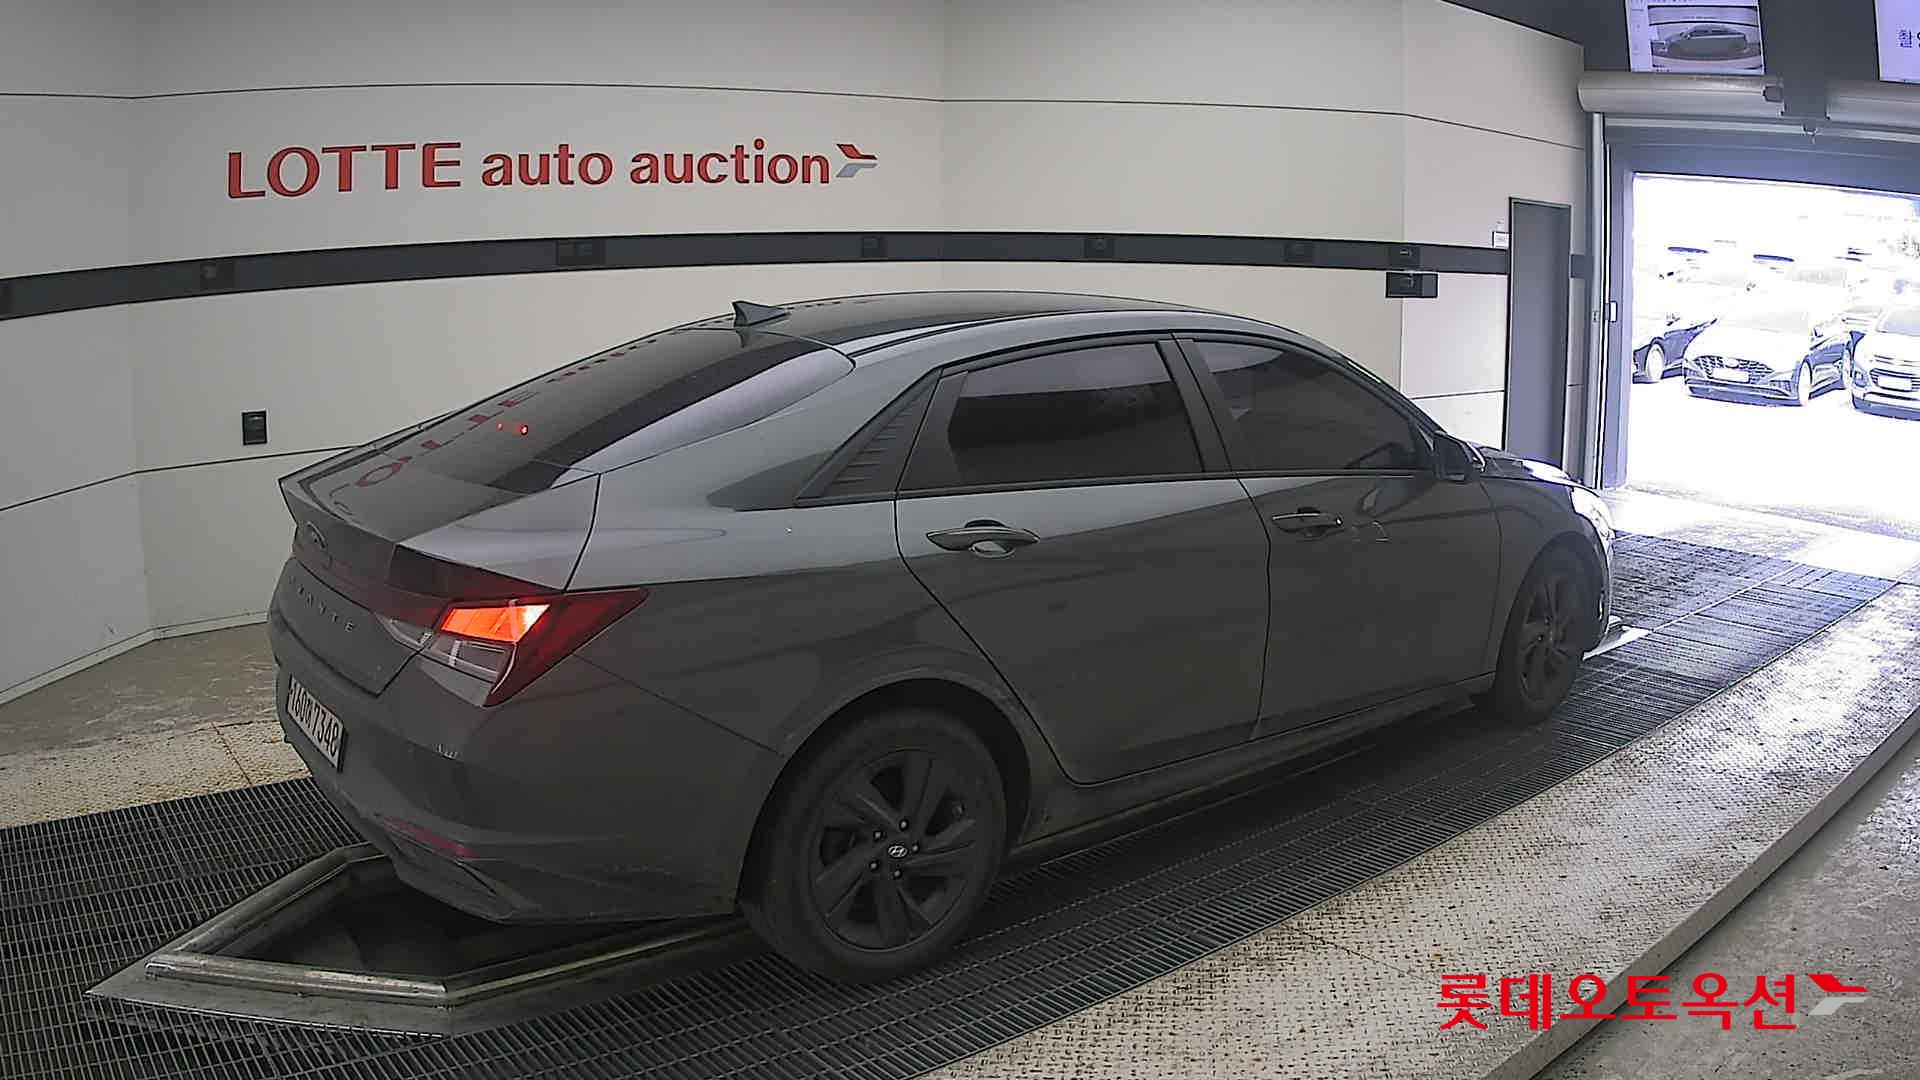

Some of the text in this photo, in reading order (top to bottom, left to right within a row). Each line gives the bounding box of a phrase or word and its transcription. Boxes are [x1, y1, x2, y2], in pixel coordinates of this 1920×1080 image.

[228, 139, 830, 199] LOTTE auto auction
